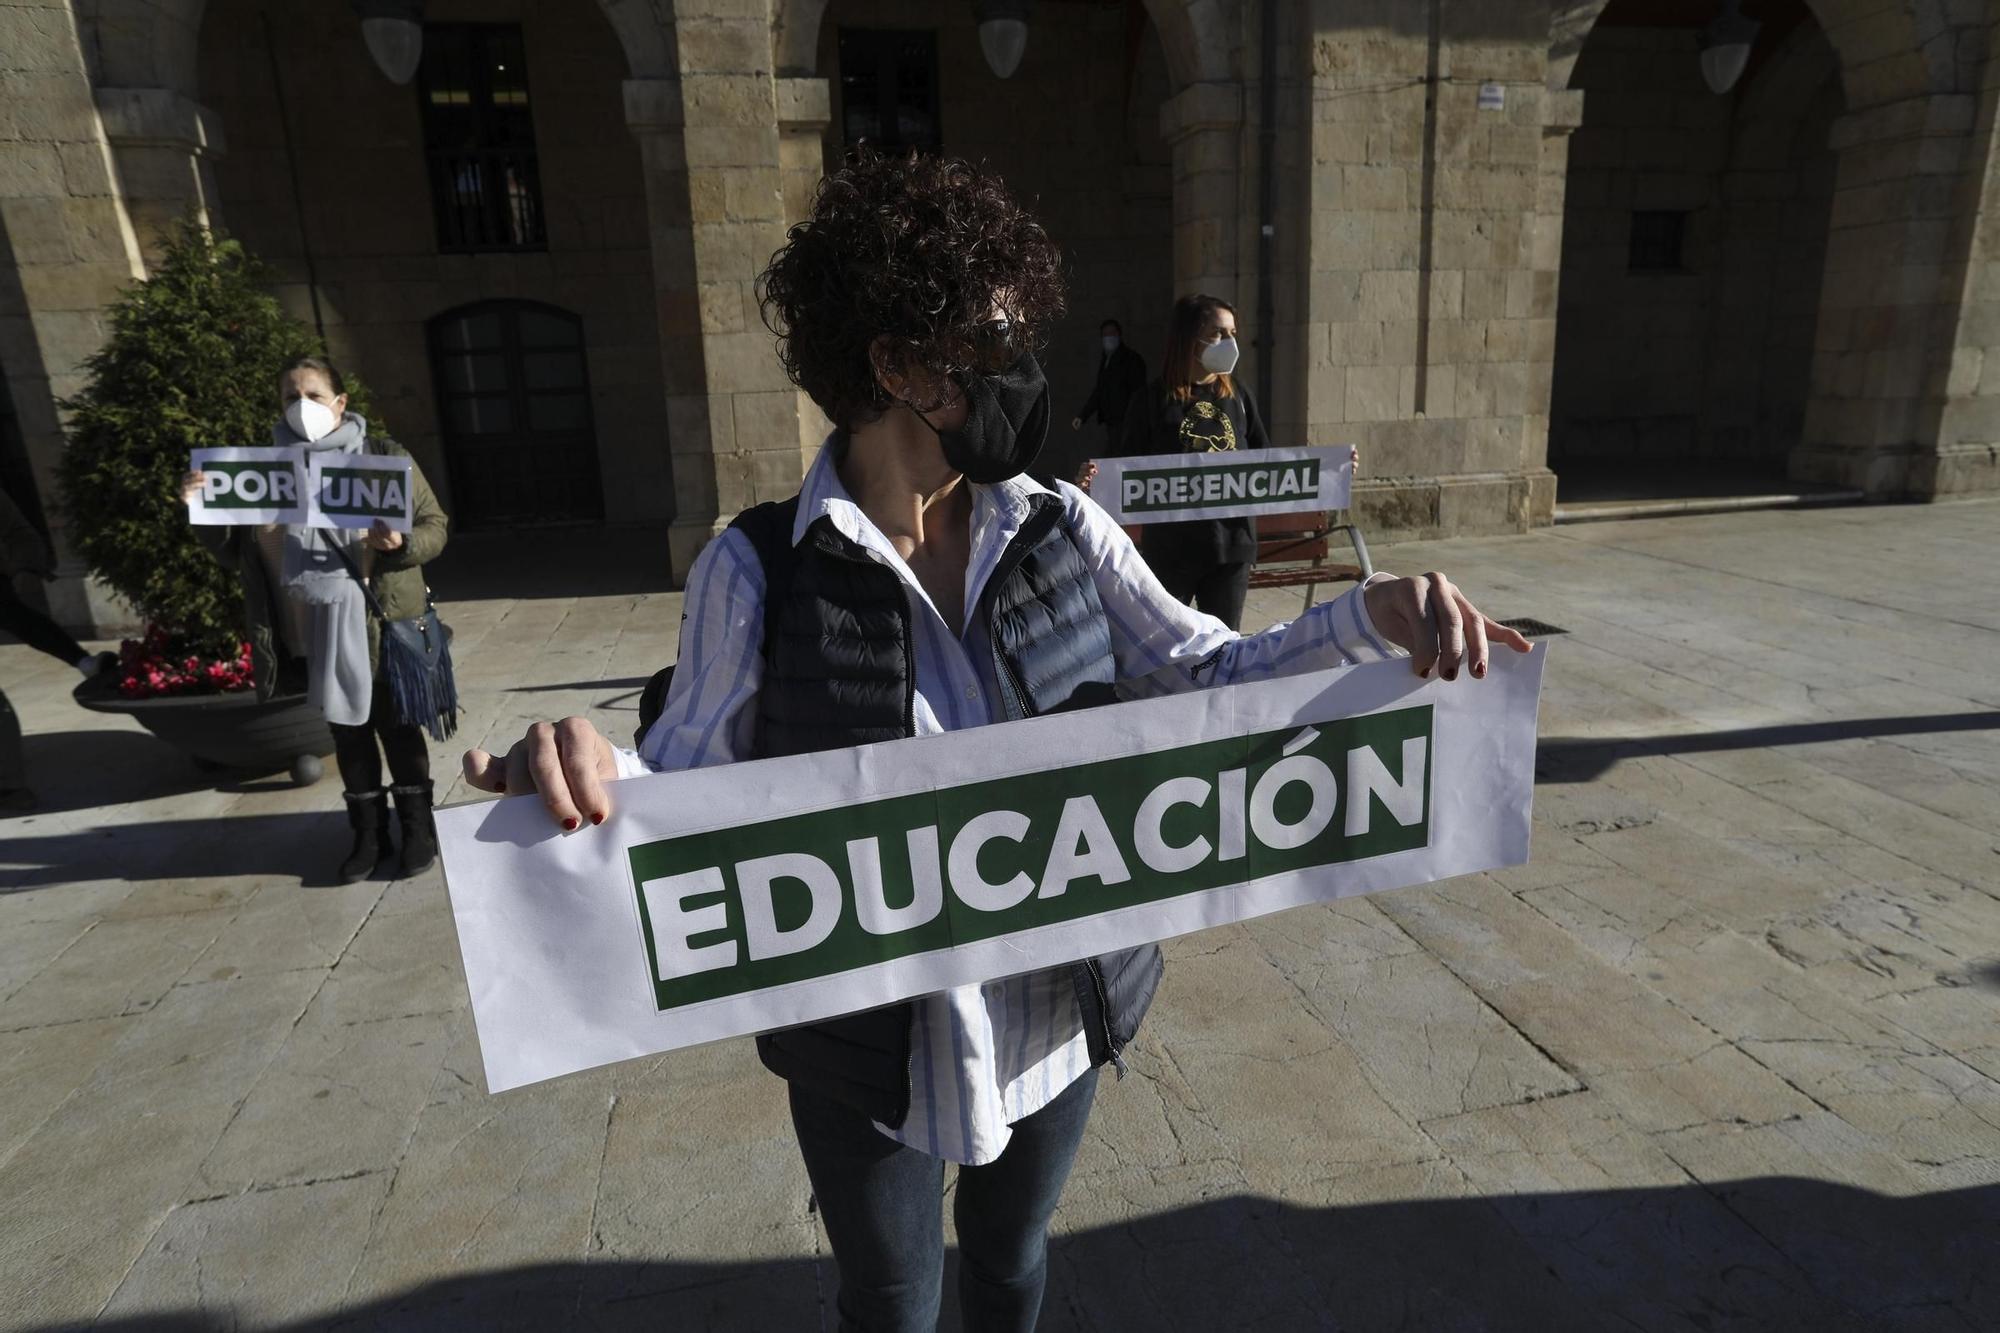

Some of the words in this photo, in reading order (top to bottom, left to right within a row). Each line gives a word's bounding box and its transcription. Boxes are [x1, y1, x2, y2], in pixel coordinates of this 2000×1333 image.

[203, 469, 297, 502] POR
[321, 475, 405, 511] UNA
[1122, 467, 1318, 506] PRESENCIAL
[641, 727, 1427, 981] EDUCACIÓN
